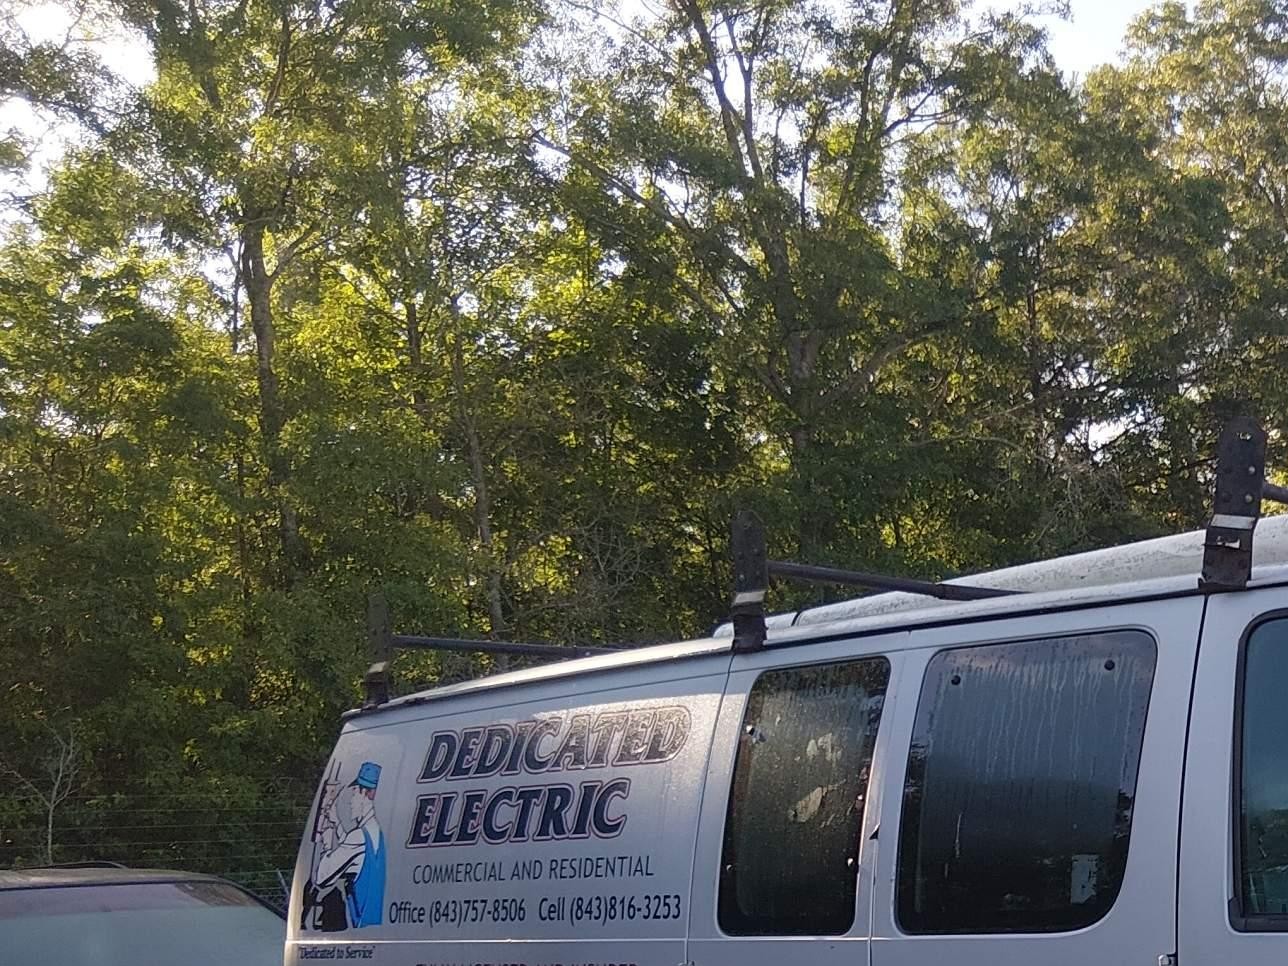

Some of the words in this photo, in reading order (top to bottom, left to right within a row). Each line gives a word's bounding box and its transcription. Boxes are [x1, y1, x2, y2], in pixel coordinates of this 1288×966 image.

[416, 705, 692, 783] DEDICATED
[405, 778, 631, 849] ELECTRIC
[413, 860, 505, 884] COMMERCIAL
[510, 859, 543, 881] AND
[550, 855, 655, 880] RESIDENTIAL
[389, 901, 425, 924] Office
[429, 898, 526, 928] (843)757-8506
[538, 897, 566, 922] Cell
[570, 894, 681, 926] (843)816-3253
